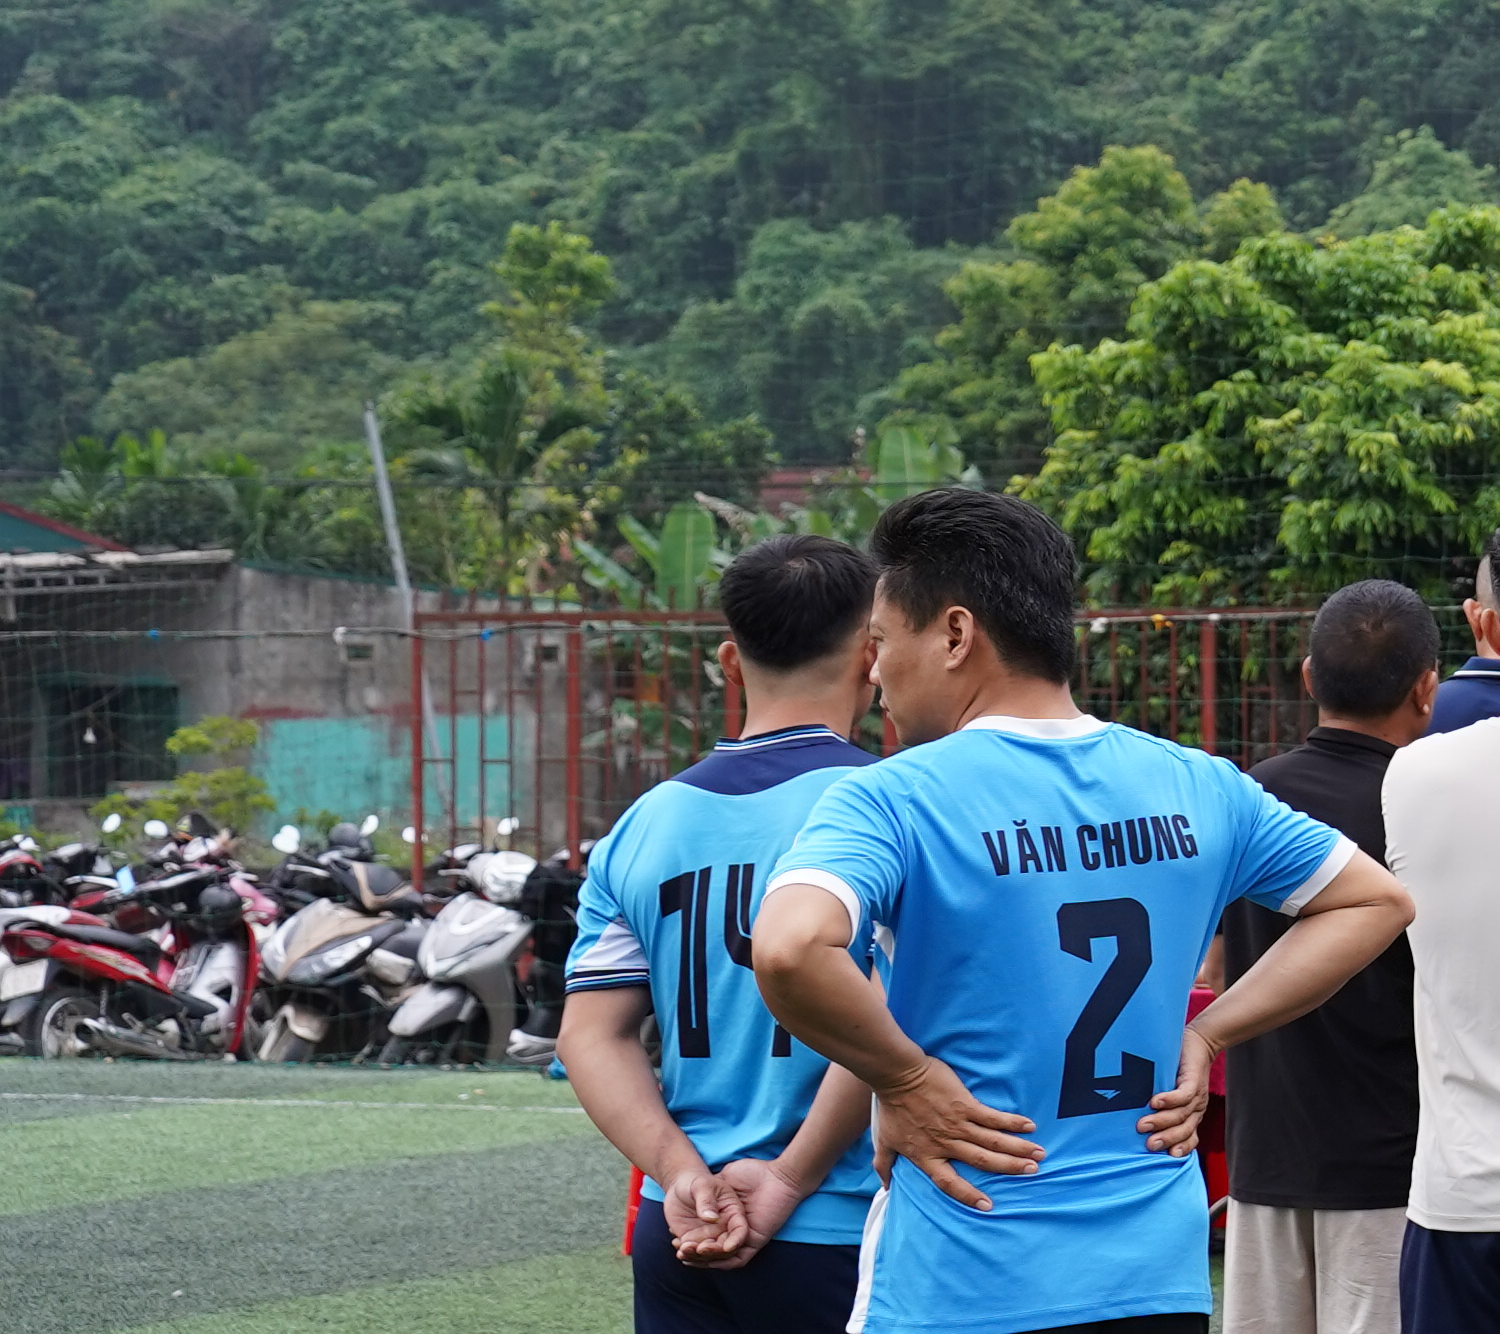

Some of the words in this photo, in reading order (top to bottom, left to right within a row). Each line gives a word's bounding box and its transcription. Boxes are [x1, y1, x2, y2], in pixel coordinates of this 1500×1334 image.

[982, 820, 1065, 876] VĂN
[1077, 814, 1199, 871] CHUNG
[1057, 897, 1155, 1119] 2
